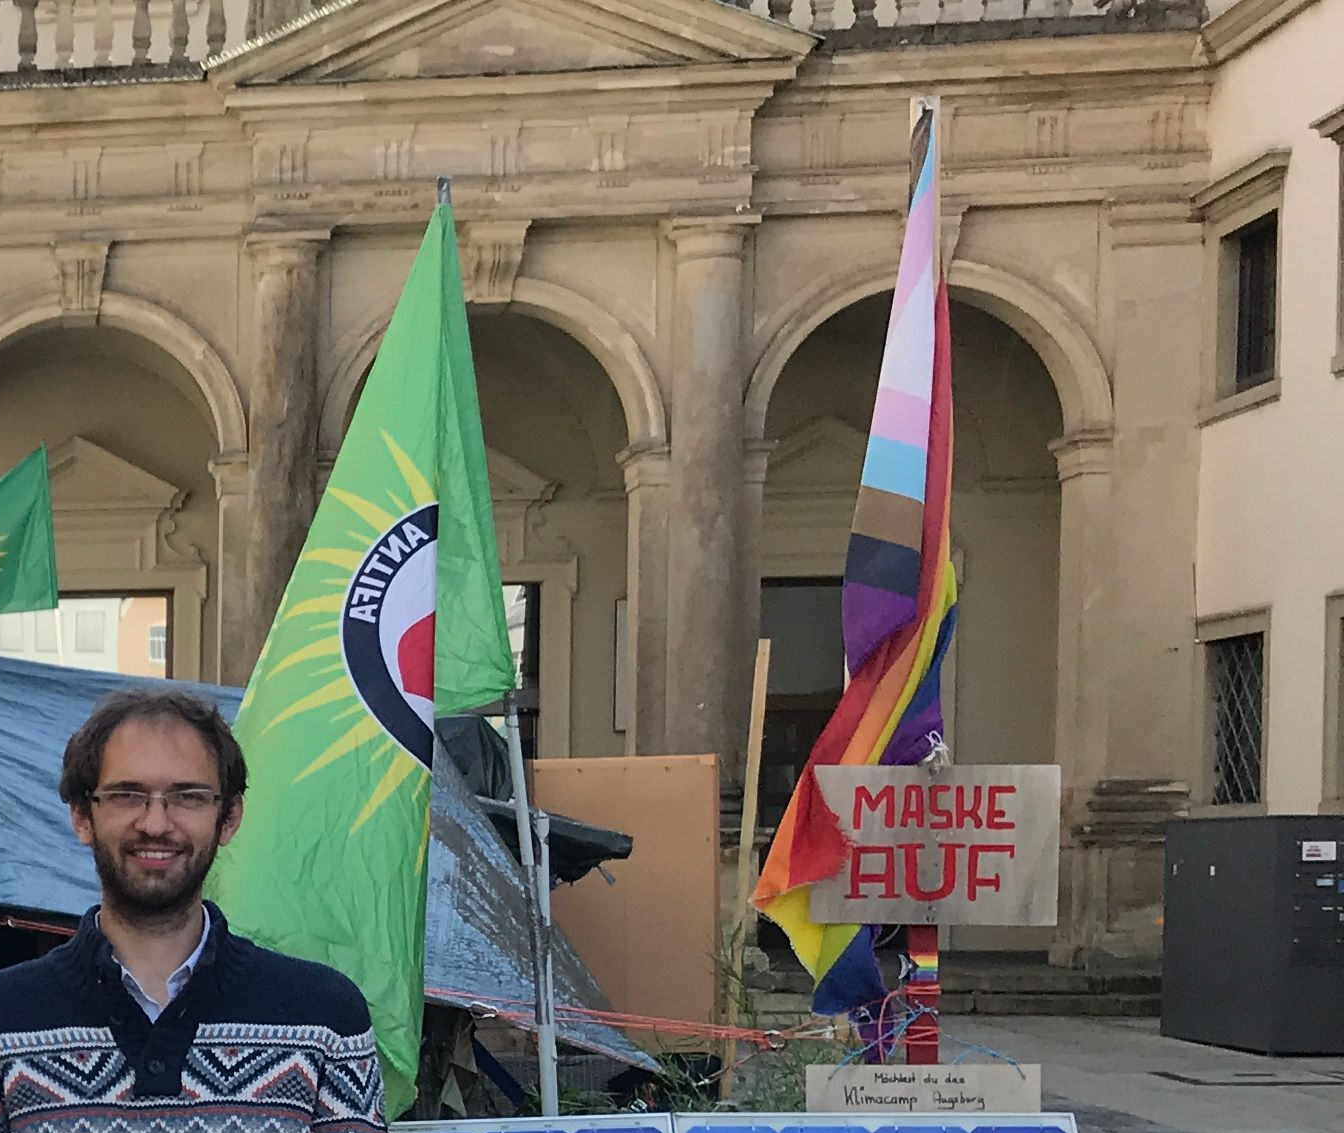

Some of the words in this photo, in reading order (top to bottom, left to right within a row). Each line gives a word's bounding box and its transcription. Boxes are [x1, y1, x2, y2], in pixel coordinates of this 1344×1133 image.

[853, 784, 1017, 830] MASKE
[844, 843, 1016, 902] AUF
[923, 1072, 939, 1084] du
[944, 1072, 966, 1084] das
[844, 1085, 918, 1111] Klimacamp
[932, 1090, 986, 1110] Augsburg
